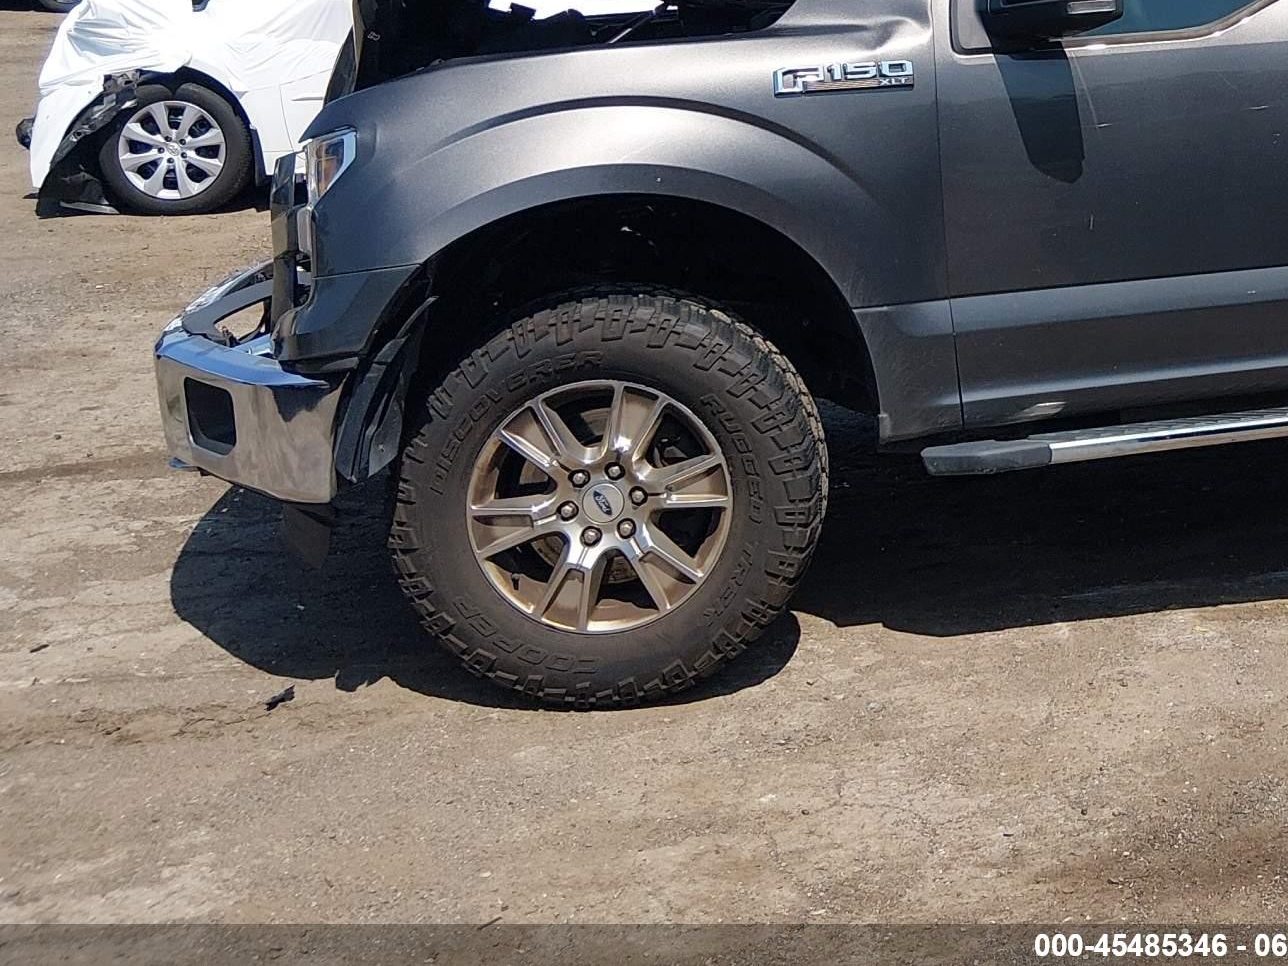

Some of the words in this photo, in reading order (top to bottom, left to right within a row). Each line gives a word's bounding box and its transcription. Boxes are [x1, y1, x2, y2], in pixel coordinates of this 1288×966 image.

[880, 77, 908, 86] XLT
[429, 350, 605, 496] DISCOVERER
[700, 394, 764, 525] RUGGED
[452, 597, 602, 674] COOPER
